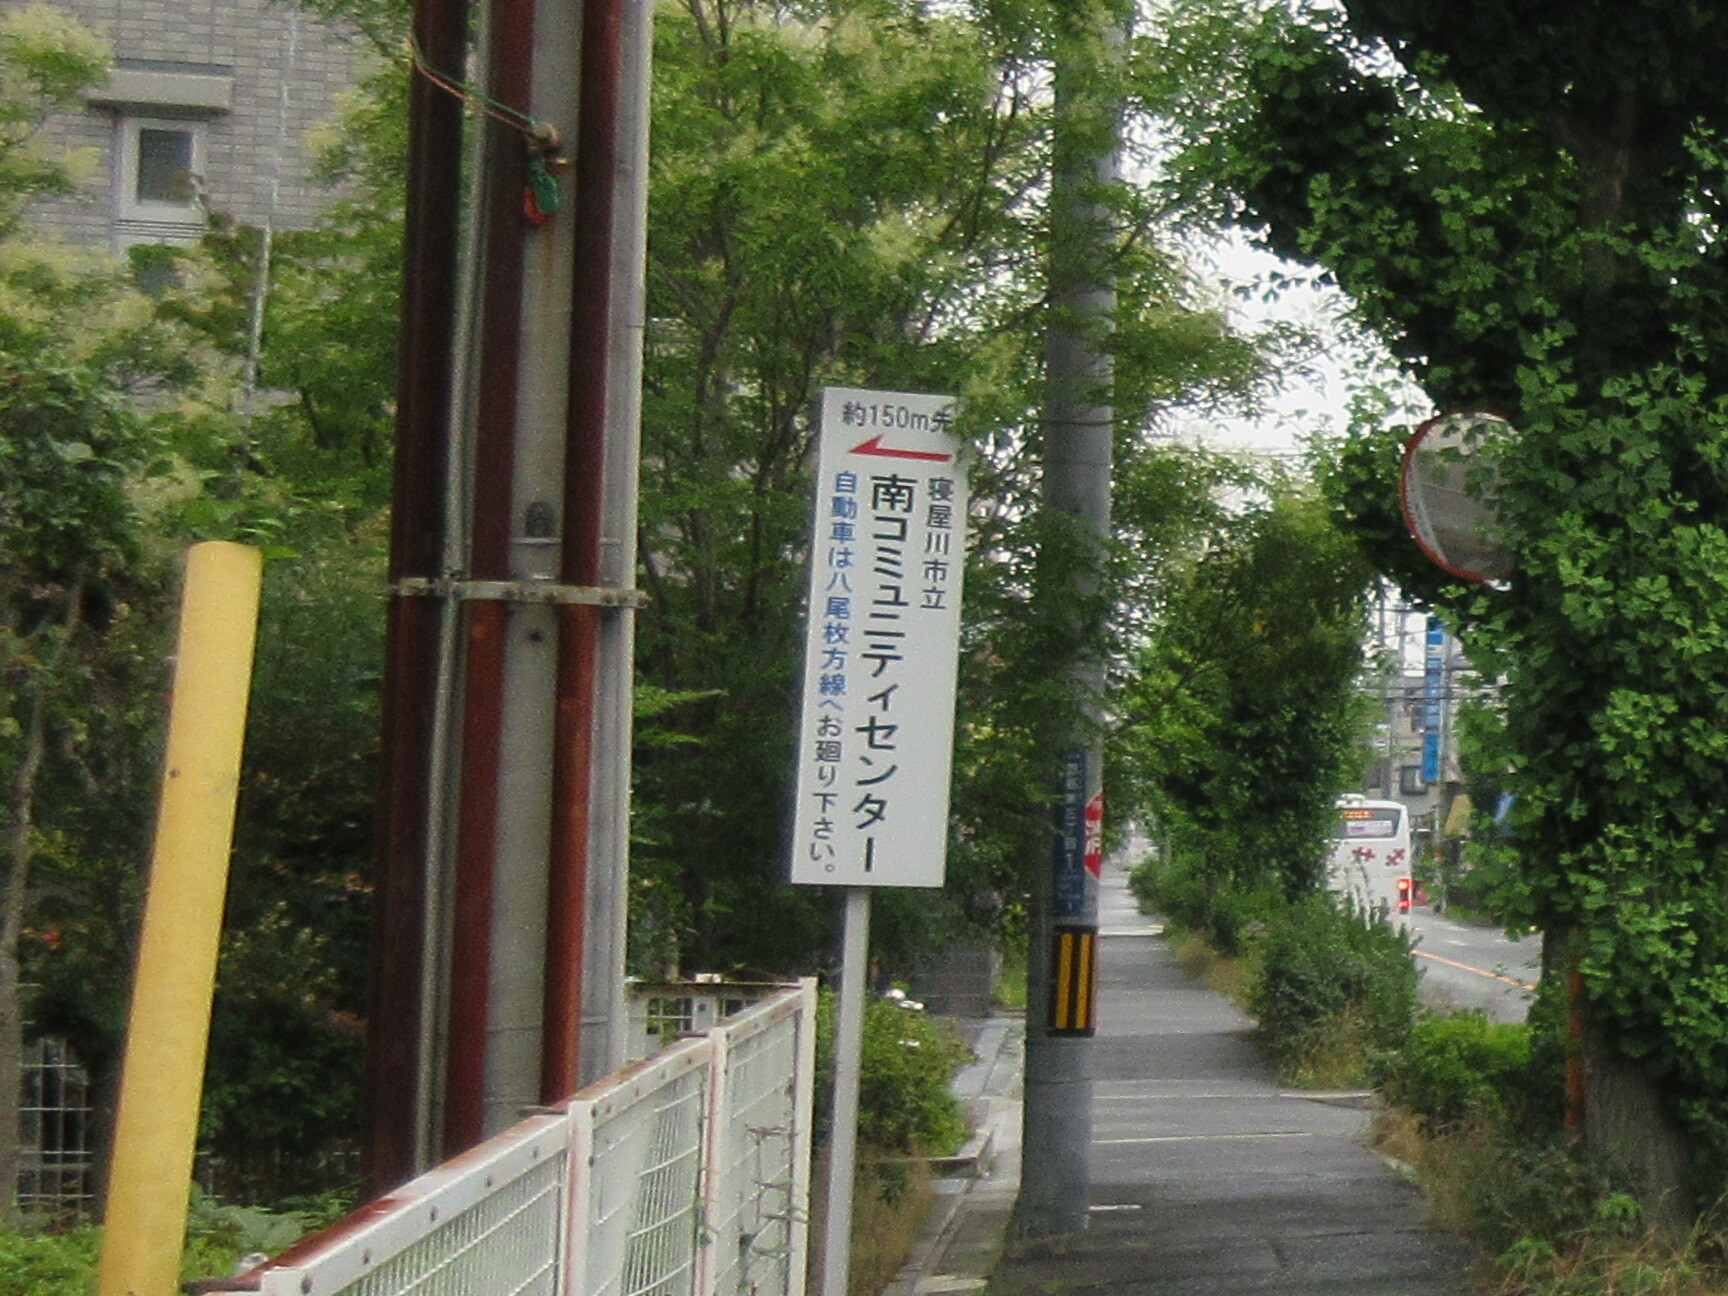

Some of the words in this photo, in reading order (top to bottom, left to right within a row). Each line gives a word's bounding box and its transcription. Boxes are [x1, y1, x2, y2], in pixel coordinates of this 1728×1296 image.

[853, 473, 919, 872] 南コミュニティセンター
[919, 477, 955, 610] 寝屋川市立
